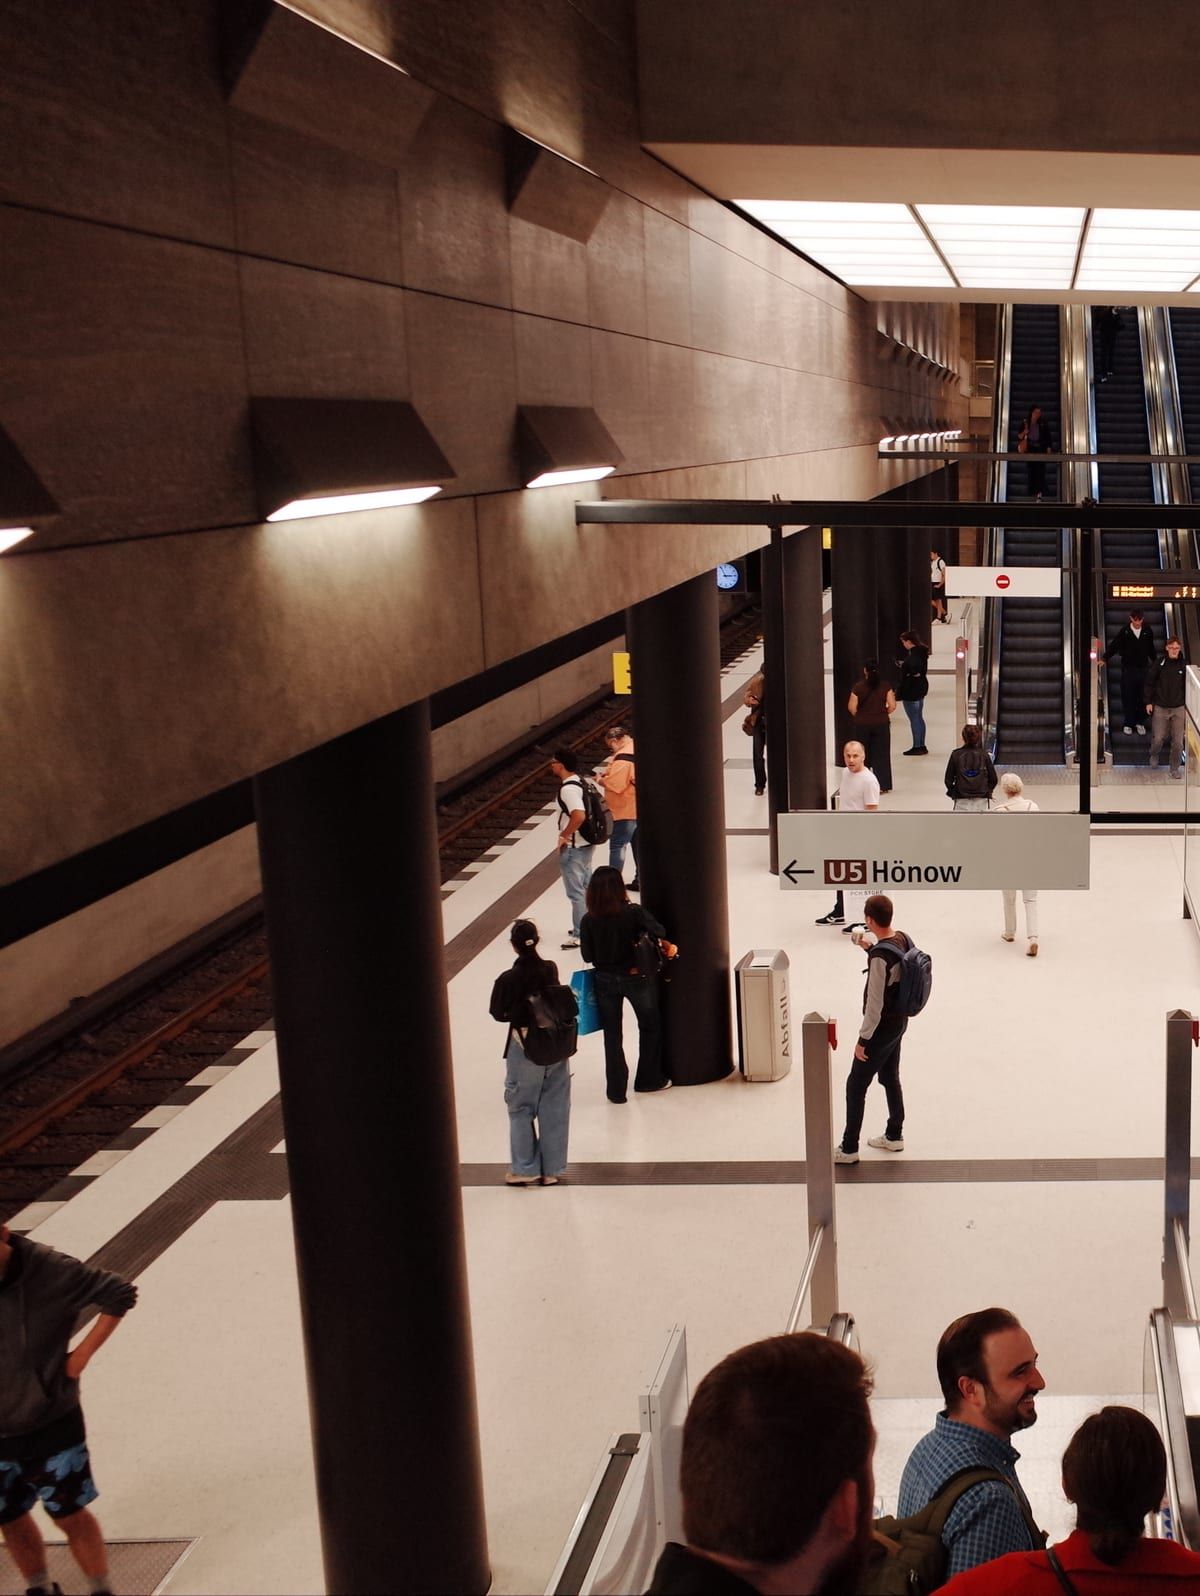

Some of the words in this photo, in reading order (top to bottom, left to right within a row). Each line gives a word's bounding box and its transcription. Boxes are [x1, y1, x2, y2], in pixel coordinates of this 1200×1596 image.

[827, 860, 865, 883] U5
[872, 860, 962, 883] Hönow
[780, 995, 790, 1057] Abfall
